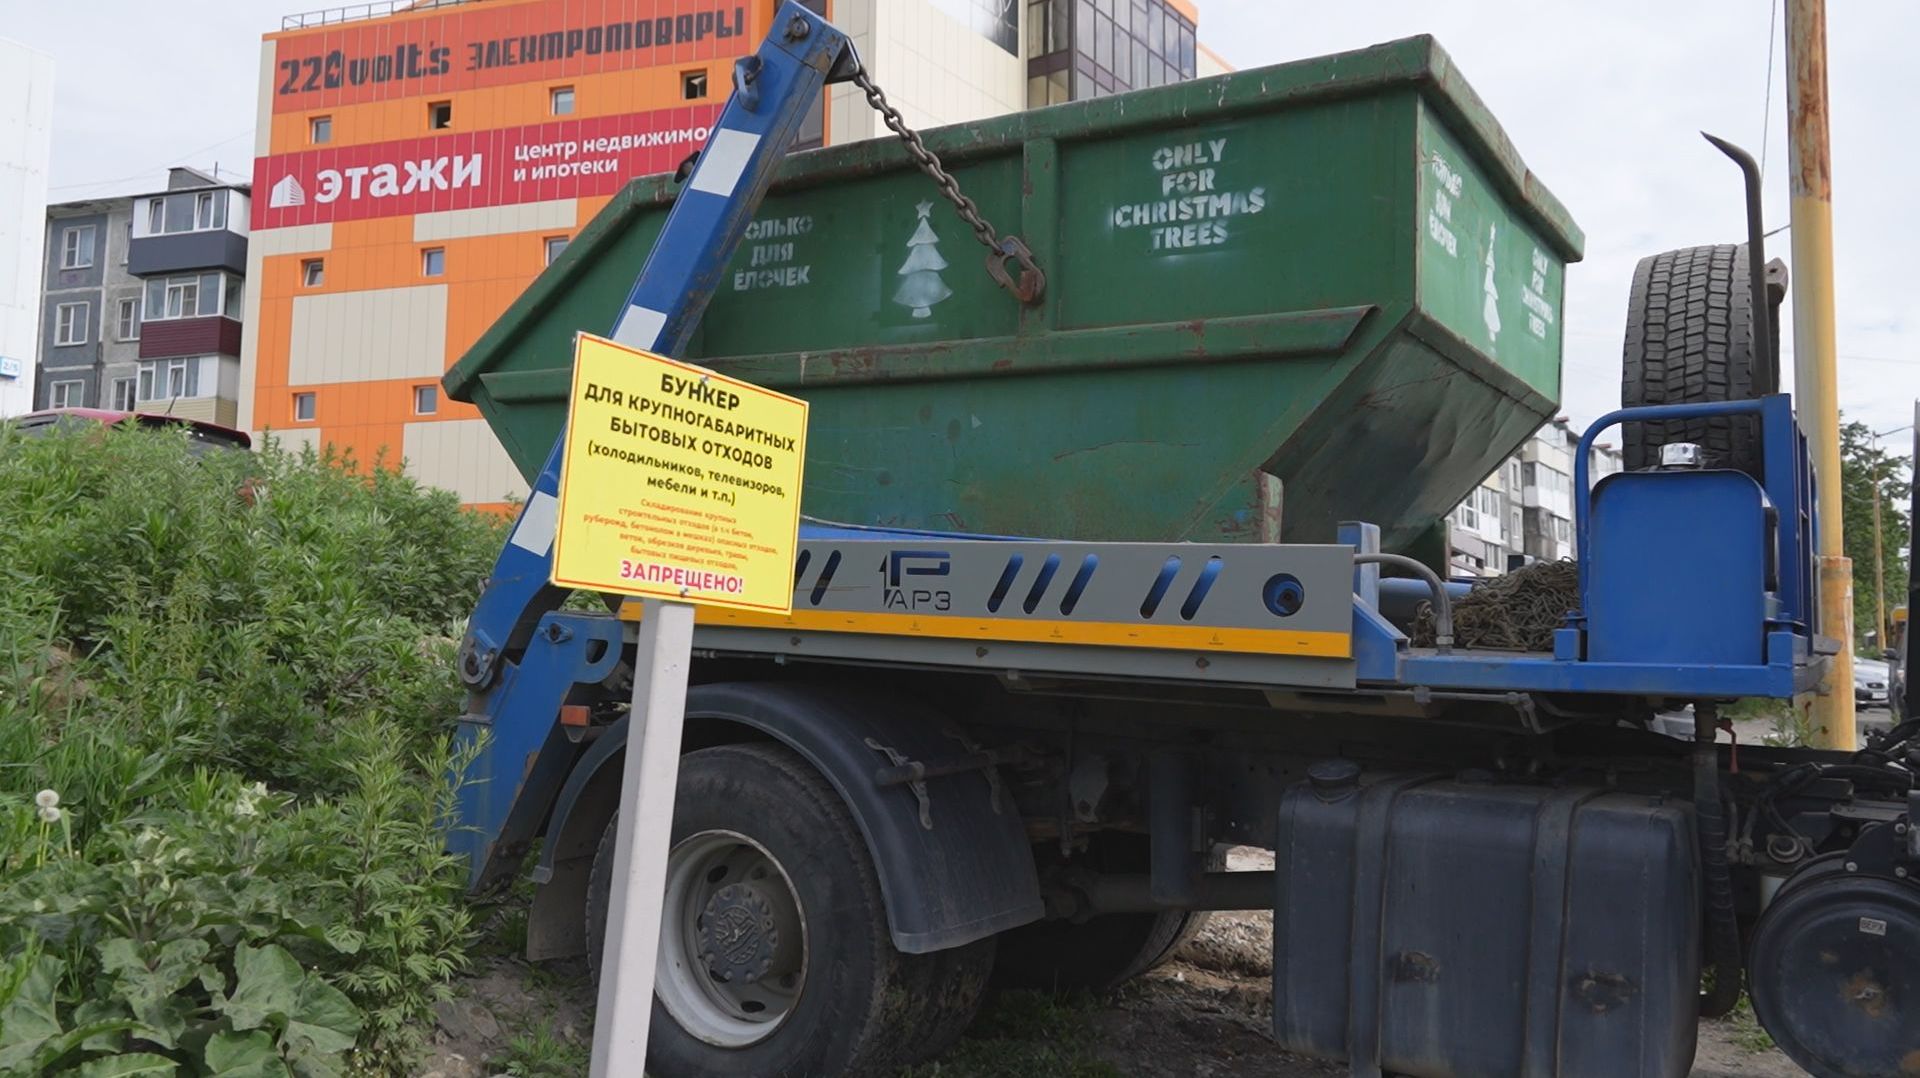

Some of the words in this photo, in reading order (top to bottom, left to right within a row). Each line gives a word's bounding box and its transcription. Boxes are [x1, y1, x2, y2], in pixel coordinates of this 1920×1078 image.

[514, 140, 577, 161] Центр
[1152, 138, 1227, 170] ONLY
[514, 168, 526, 182] и
[531, 158, 618, 180] ипотеки
[1162, 168, 1216, 197] FOR
[1115, 186, 1266, 227] CHRISTMAS
[744, 216, 813, 240] ОЛЬКО
[1151, 219, 1229, 249] TREES
[750, 242, 794, 267] ДЛЯ
[733, 265, 810, 291] ЁЛОЧЕК
[660, 373, 740, 411] БУНКЕР
[584, 383, 623, 406] ДЛЯ
[629, 395, 795, 452] КРУПНОГАБАРИТНЫХ
[610, 416, 697, 451] БЫТОВЫХ
[702, 440, 773, 470] ОТХОДОВ
[588, 440, 704, 480] (холодильников,
[708, 470, 785, 498] телевизоров,
[647, 476, 697, 496] мебели
[701, 486, 708, 498] и
[712, 489, 736, 506] т.п.)
[621, 560, 743, 593] ЗАПРЕЩЕНО!
